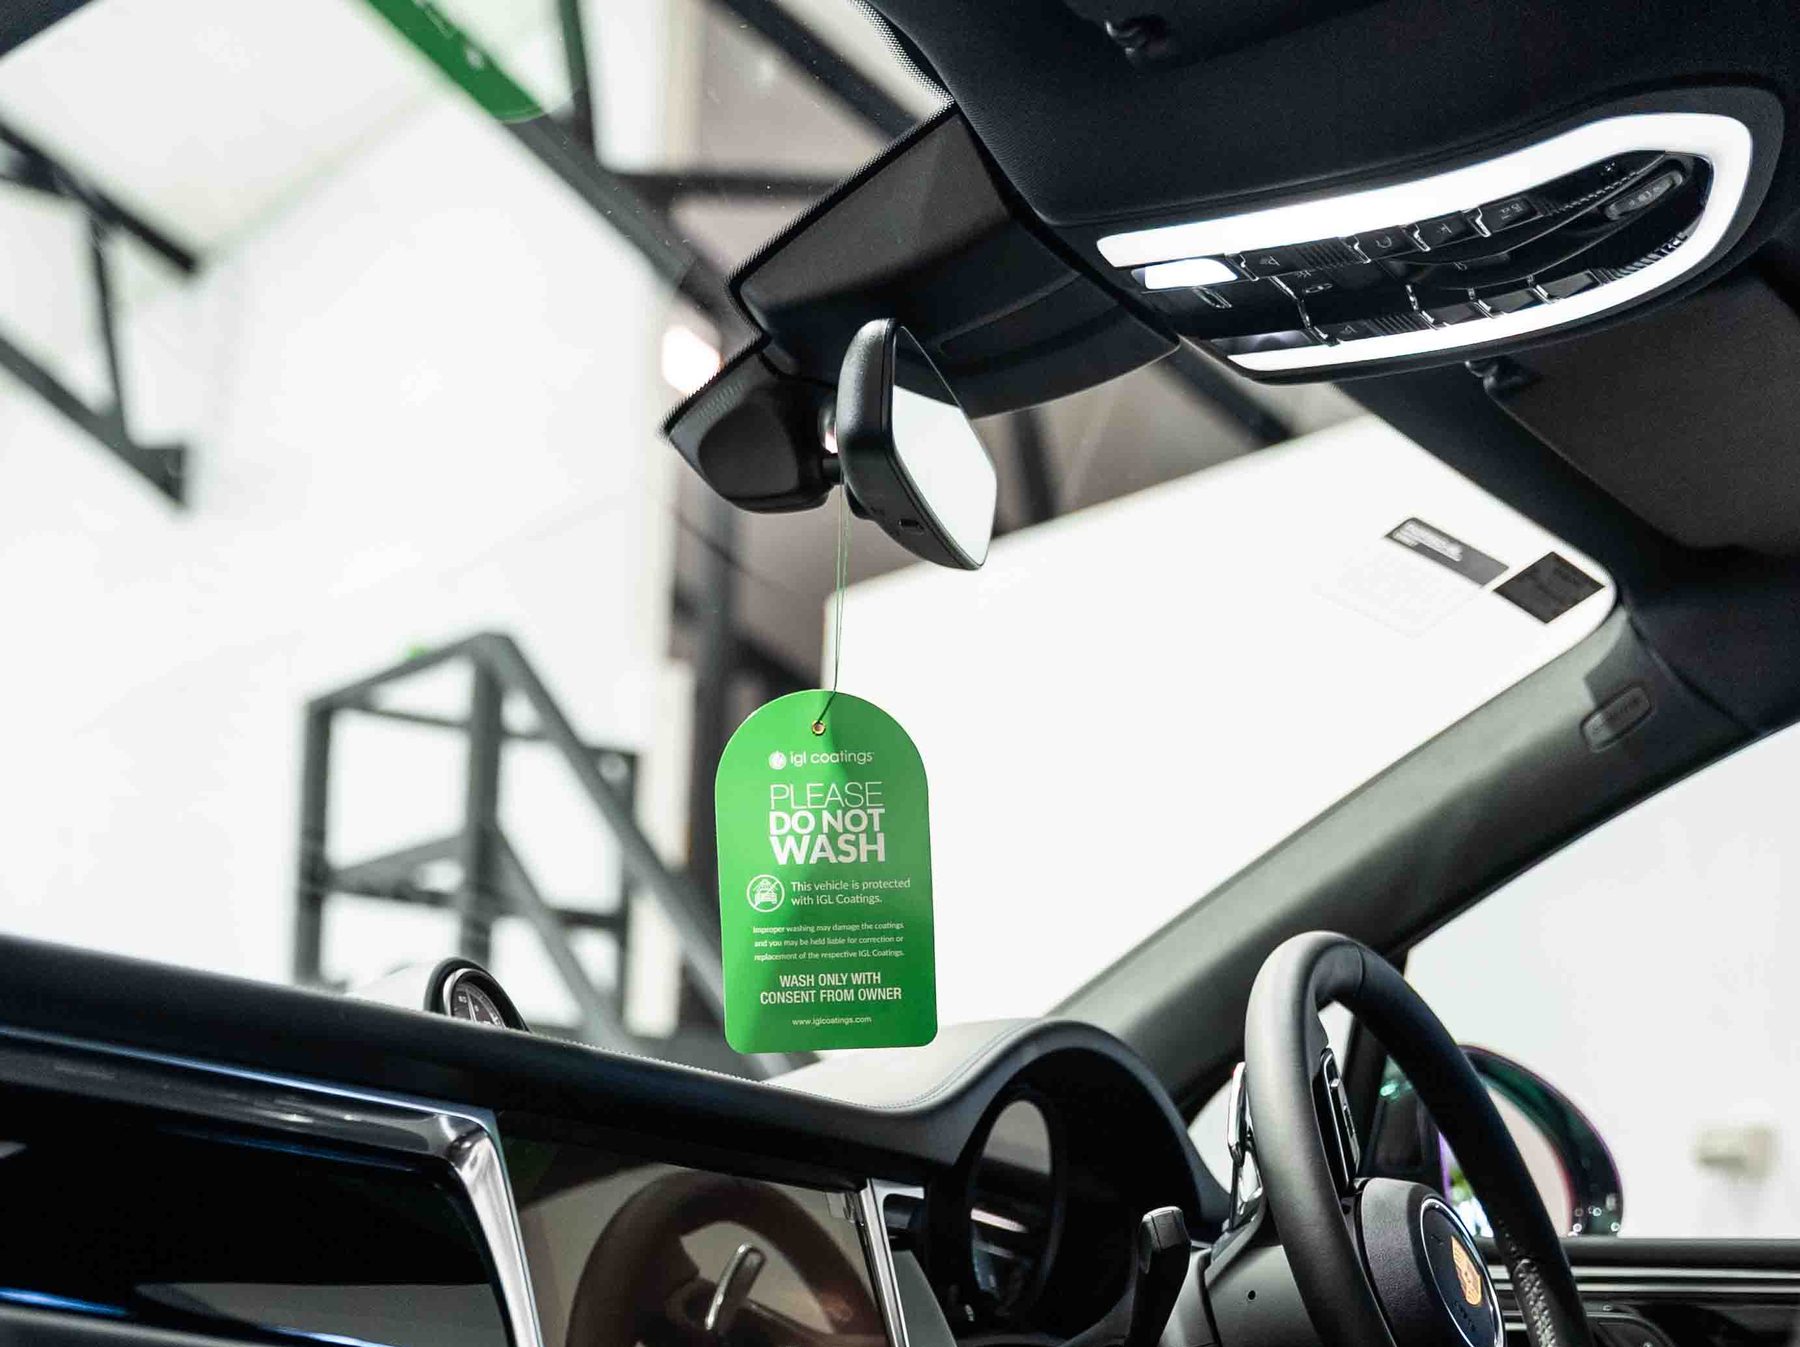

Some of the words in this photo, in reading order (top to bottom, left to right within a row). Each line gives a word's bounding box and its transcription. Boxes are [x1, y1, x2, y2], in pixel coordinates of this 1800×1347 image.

[790, 751, 807, 766] igl
[811, 750, 873, 765] coatings
[769, 781, 884, 810] PLEASE
[769, 810, 816, 836] DO
[822, 808, 885, 834] NOT
[769, 832, 886, 865] WASH
[791, 881, 812, 892] This
[814, 880, 849, 891] vehicle
[852, 879, 860, 890] is
[863, 878, 911, 891] protected
[791, 895, 814, 906] with
[816, 894, 834, 905] IGL
[836, 893, 882, 905] Coatings.
[753, 925, 785, 935] Improper
[786, 924, 815, 934] washing
[816, 924, 831, 932] may
[832, 923, 860, 932] damage
[861, 922, 873, 930] the
[769, 940, 782, 948] you
[799, 938, 809, 946] be
[810, 937, 826, 945] held
[827, 936, 846, 945] liable
[847, 935, 857, 944] for
[859, 935, 894, 944] correction
[754, 952, 797, 962] replacement
[799, 951, 806, 959] of
[807, 951, 820, 959] the
[821, 949, 857, 959] respective
[858, 949, 871, 958] IGL
[779, 974, 815, 988] WASH
[818, 972, 849, 986] ONLY
[851, 971, 881, 985] WITH
[760, 990, 817, 1005] CONSENT
[820, 988, 854, 1002] FROM
[858, 987, 902, 1001] OWNER
[792, 1015, 872, 1026] www.iglcoatings.com
